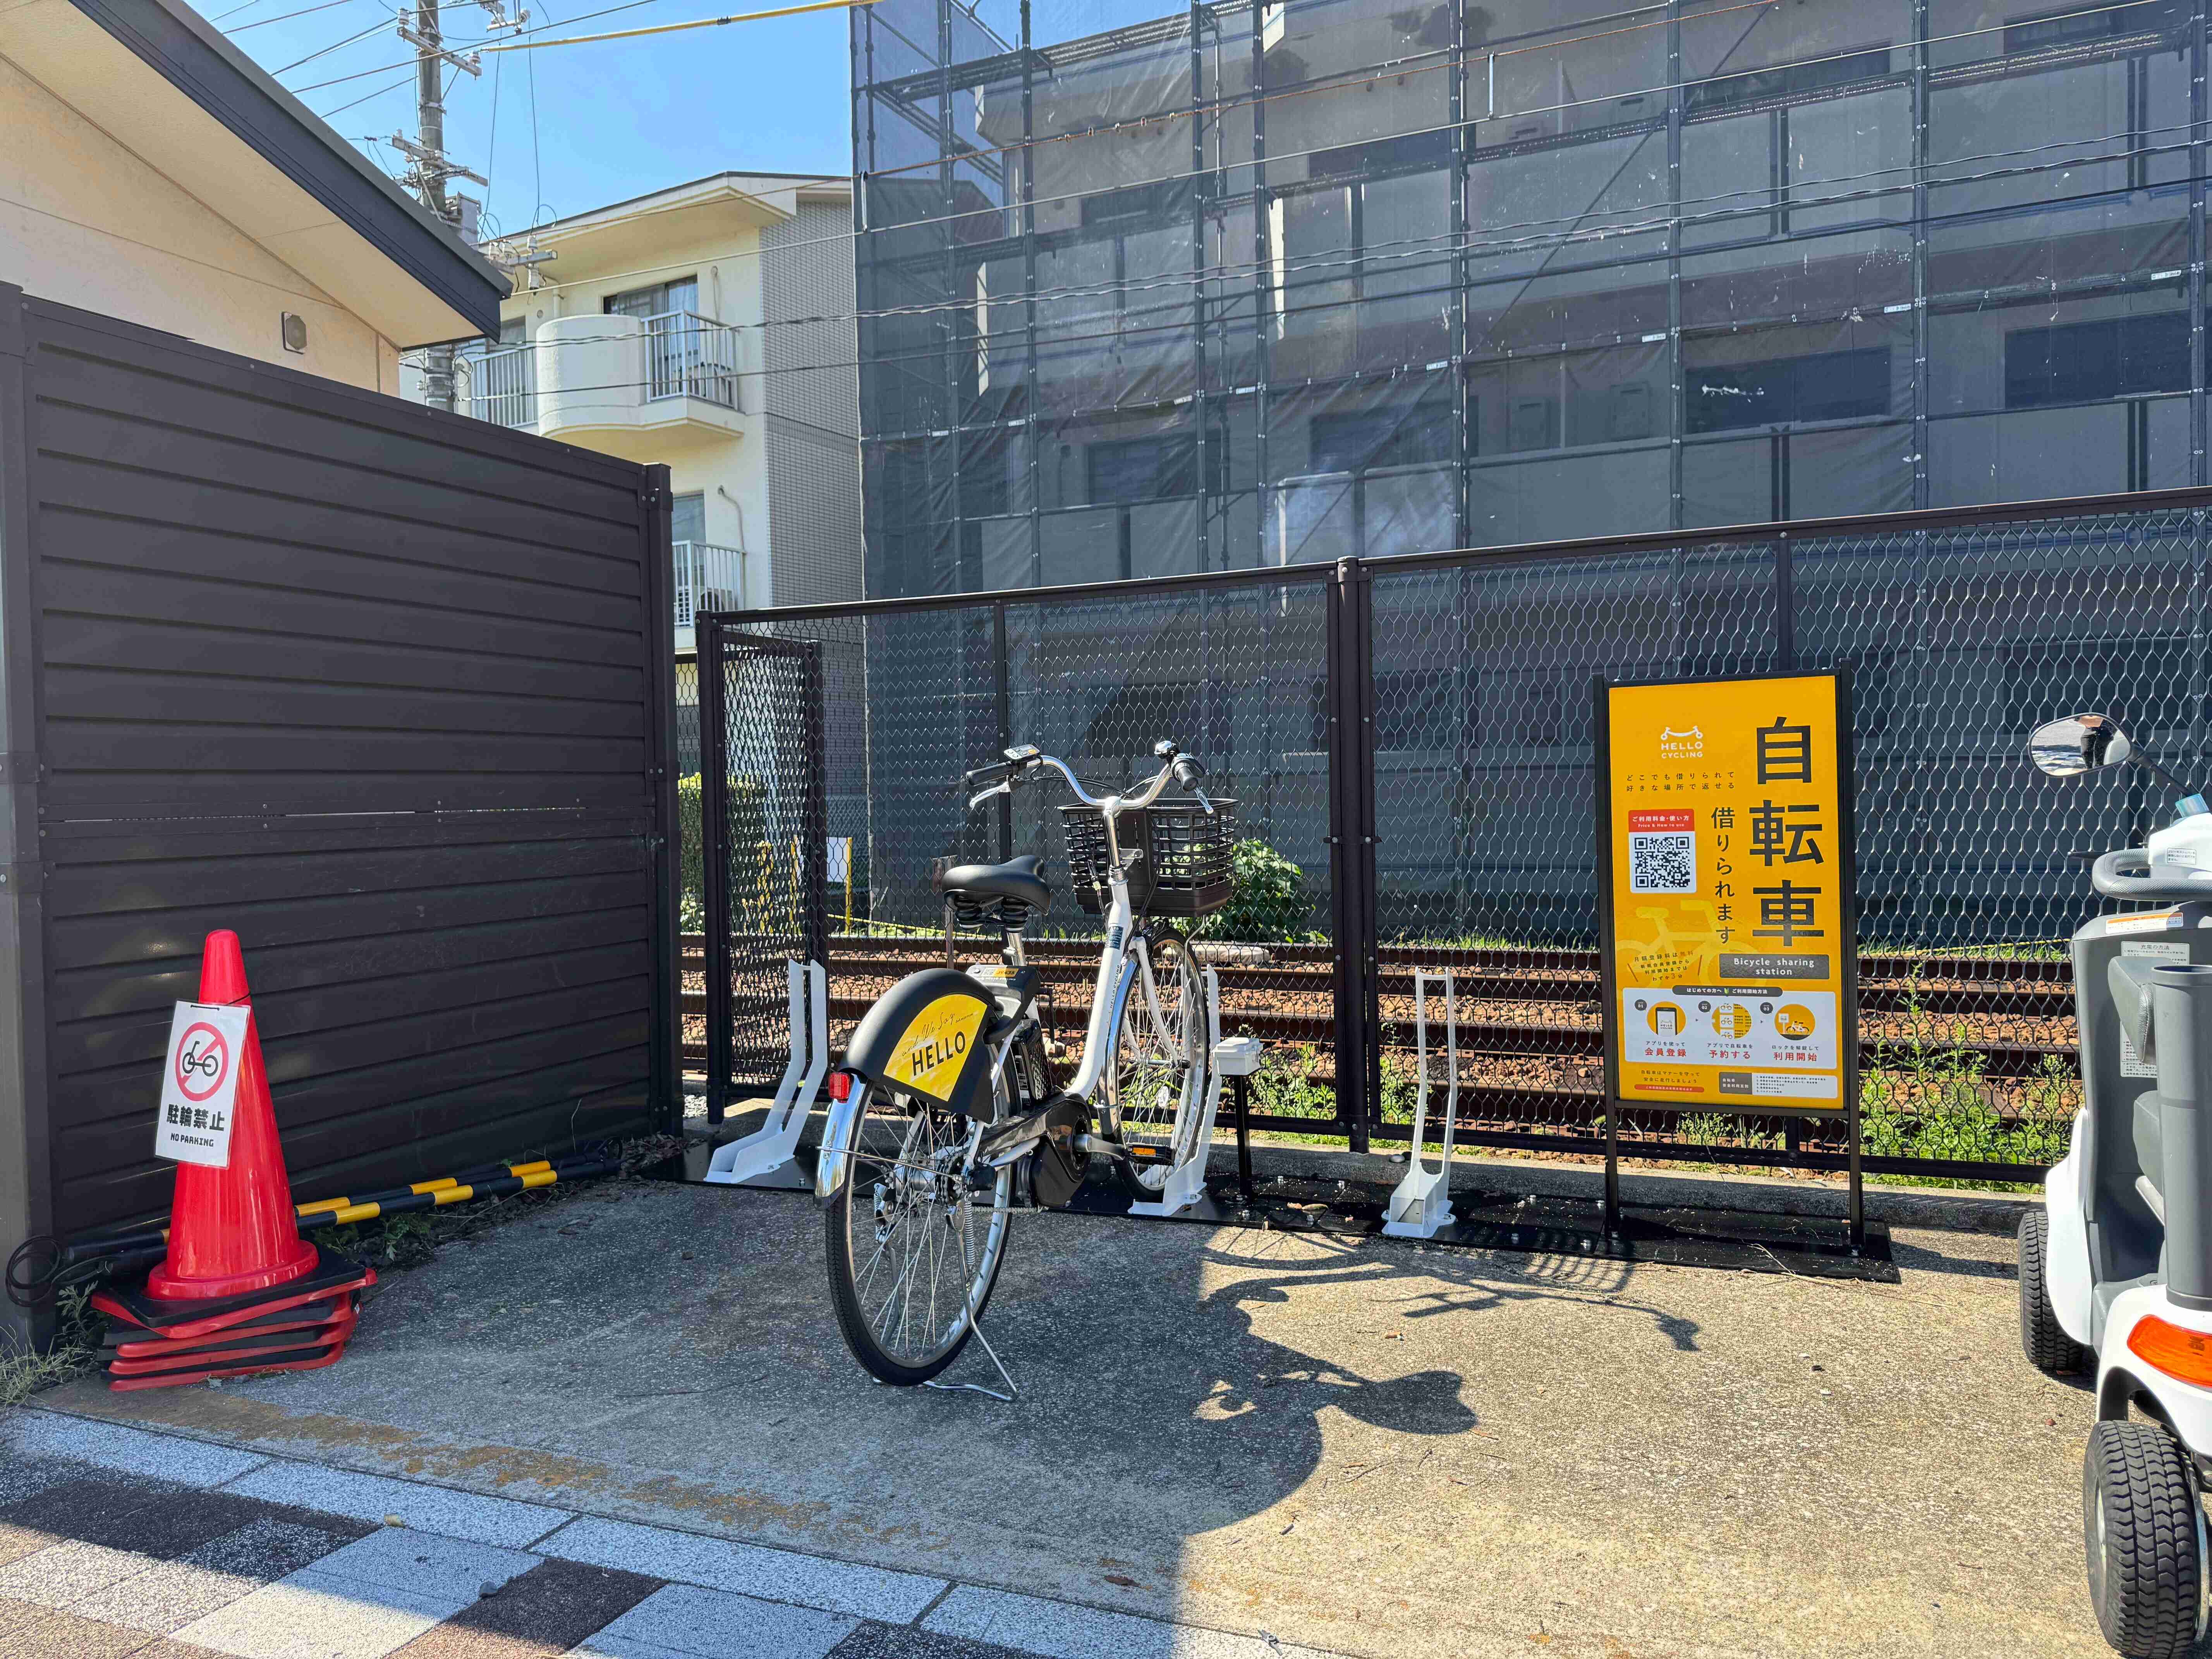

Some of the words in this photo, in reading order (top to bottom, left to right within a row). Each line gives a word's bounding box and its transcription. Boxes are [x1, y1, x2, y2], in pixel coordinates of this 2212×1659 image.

[1661, 741, 1703, 750] HELLO
[1626, 772, 1734, 781] どこでも借りられて
[1626, 782, 1734, 792] 好きな場所で返せる
[1749, 716, 1824, 946] 自転車
[1711, 807, 1735, 944] 借りられます
[1734, 958, 1770, 967] Bicycle
[1777, 958, 1815, 968] sharing
[912, 1031, 966, 1076] HELLO
[1645, 1048, 1686, 1057] 会員登録
[1709, 1050, 1750, 1059] 予約する
[1773, 1052, 1817, 1062] 利用開始
[167, 1104, 225, 1132] 駐輪禁止
[170, 1133, 179, 1142] NO
[180, 1135, 214, 1147] PARKING
